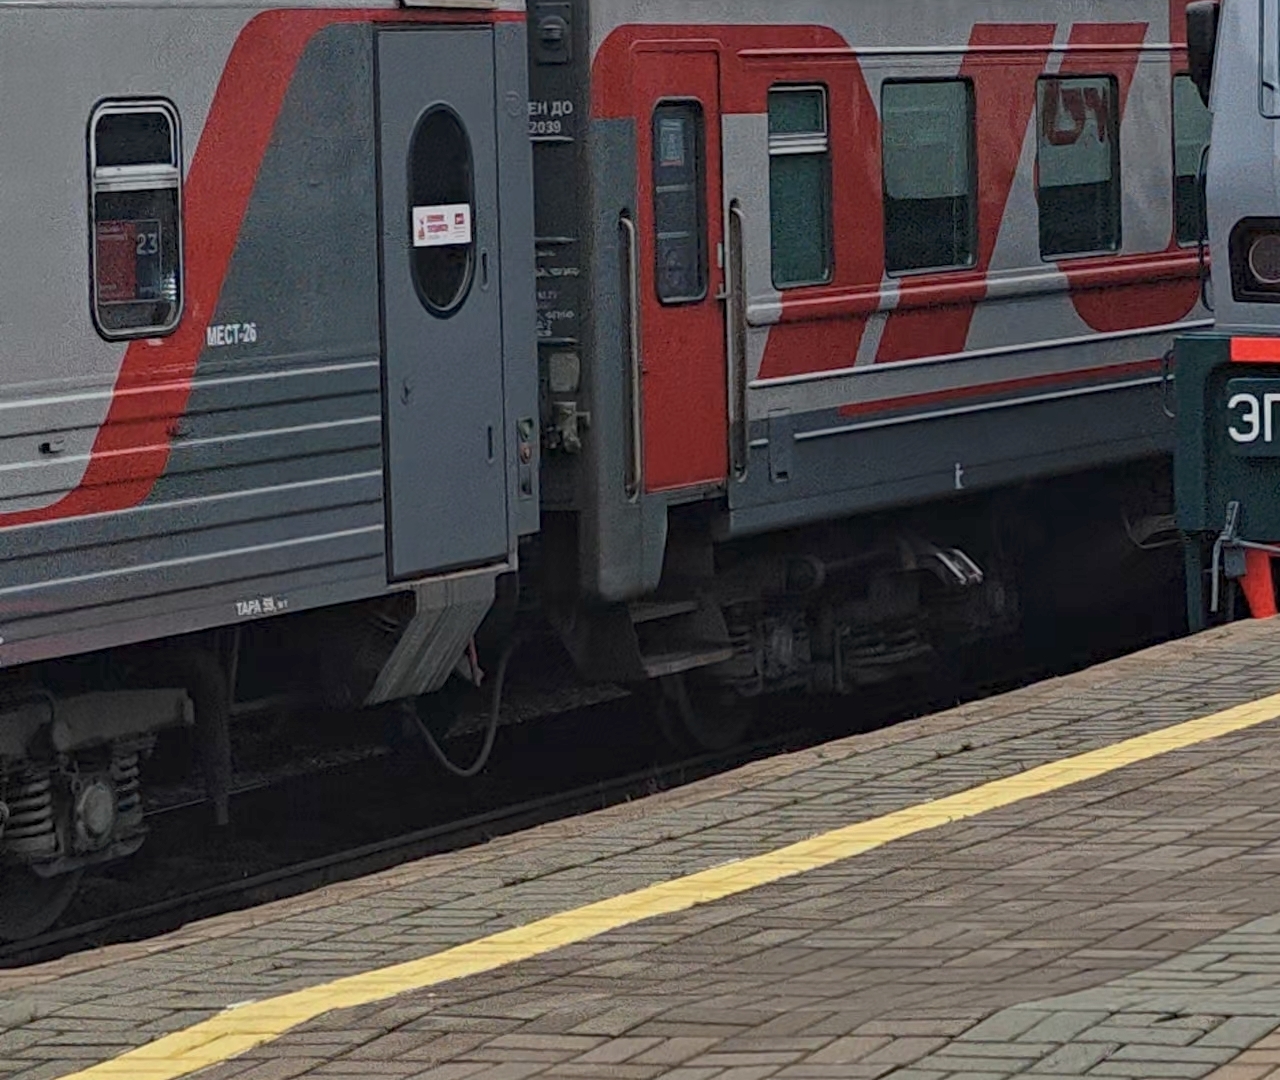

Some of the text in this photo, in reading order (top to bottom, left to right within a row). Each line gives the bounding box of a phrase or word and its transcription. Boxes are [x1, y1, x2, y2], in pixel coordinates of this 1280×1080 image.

[550, 100, 574, 117] ДО
[136, 233, 158, 255] 23
[206, 322, 257, 347] МЕСТ-26
